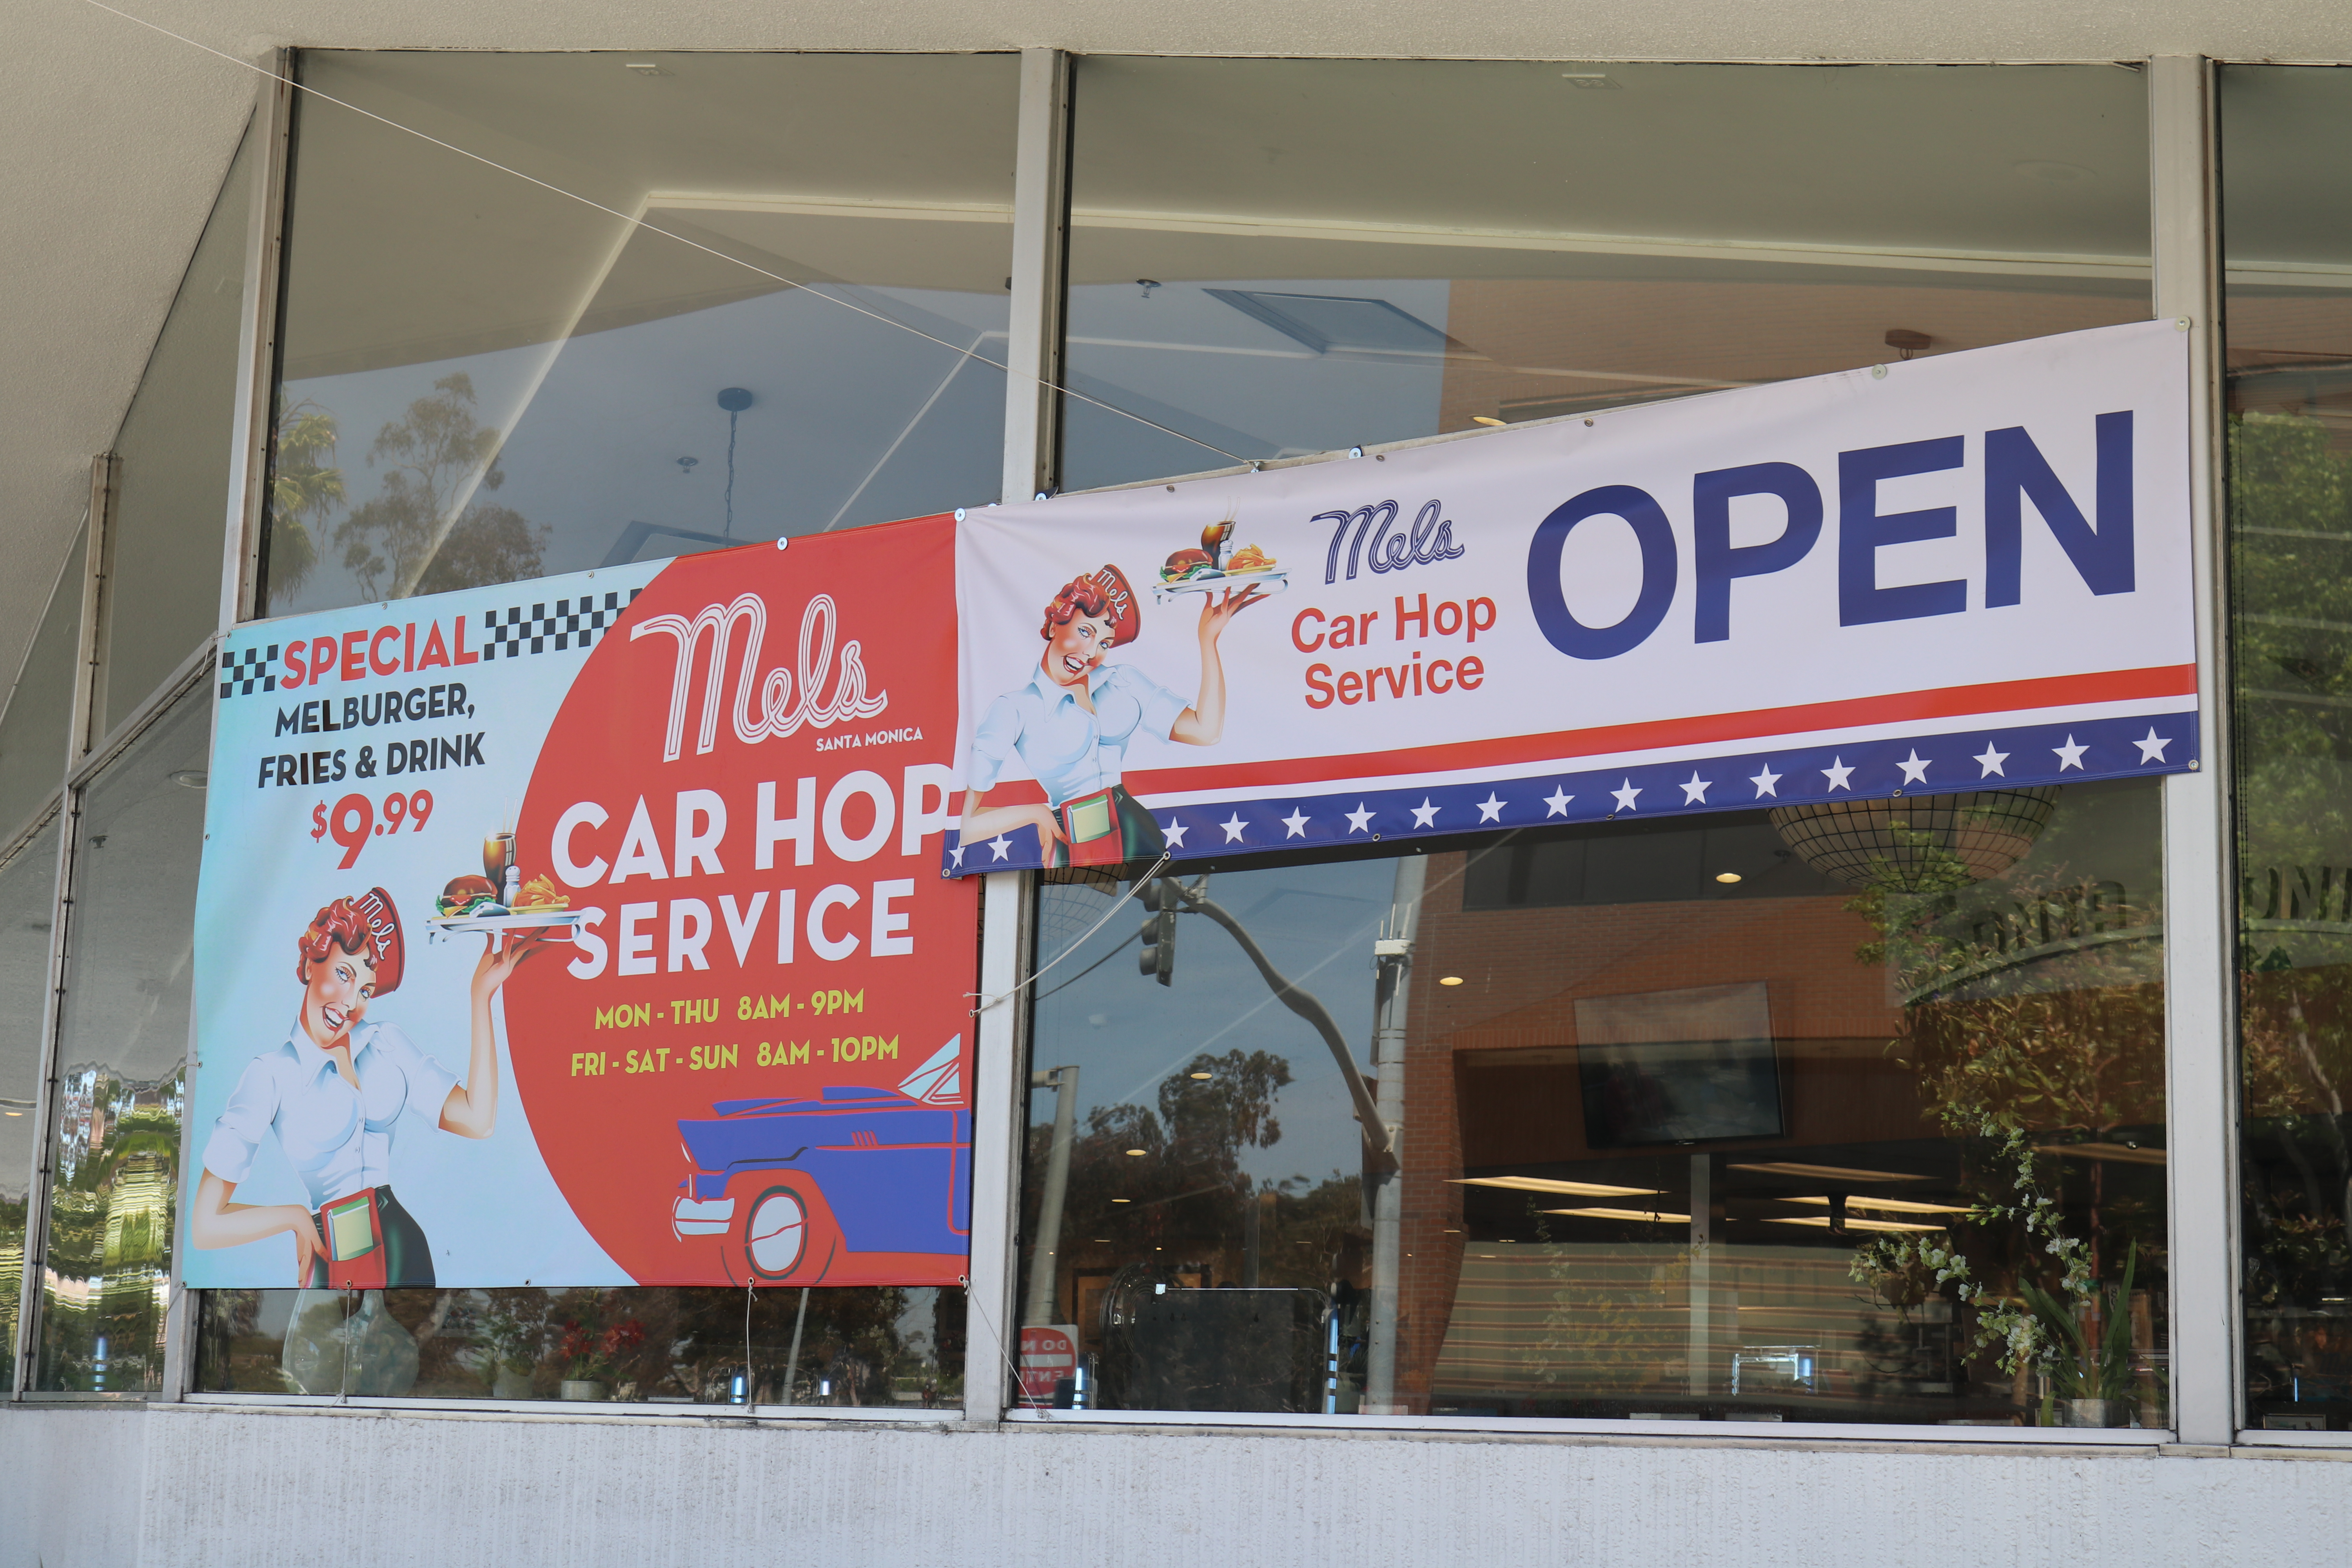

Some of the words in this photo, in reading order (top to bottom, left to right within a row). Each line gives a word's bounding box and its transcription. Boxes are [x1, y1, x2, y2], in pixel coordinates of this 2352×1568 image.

[1310, 499, 1465, 585] Mels
[1527, 410, 2136, 660] OPEN
[281, 615, 479, 689] SPECIAL
[1292, 608, 1378, 652] Car
[1396, 593, 1496, 642] Hop
[275, 682, 474, 737] MELBURGER,
[630, 592, 889, 763] Mels
[1305, 652, 1484, 709] Service
[259, 750, 346, 788] FRIES
[356, 746, 376, 778] &
[387, 732, 485, 775] DRINK
[816, 734, 861, 751] SANTA
[866, 727, 923, 746] MONICA
[311, 790, 433, 869] $9.99
[552, 789, 726, 887] CAR
[755, 763, 954, 870] HOP
[567, 878, 915, 980] SERVICE
[595, 1003, 650, 1029] MON
[671, 998, 719, 1024] THU
[738, 994, 789, 1020] 8AM
[811, 988, 864, 1015] 9PM
[572, 1052, 606, 1076] FRI
[625, 1048, 670, 1073] SAT
[689, 1044, 738, 1070] SUN
[757, 1040, 809, 1066] 8AM
[831, 1034, 898, 1062] 10PM
